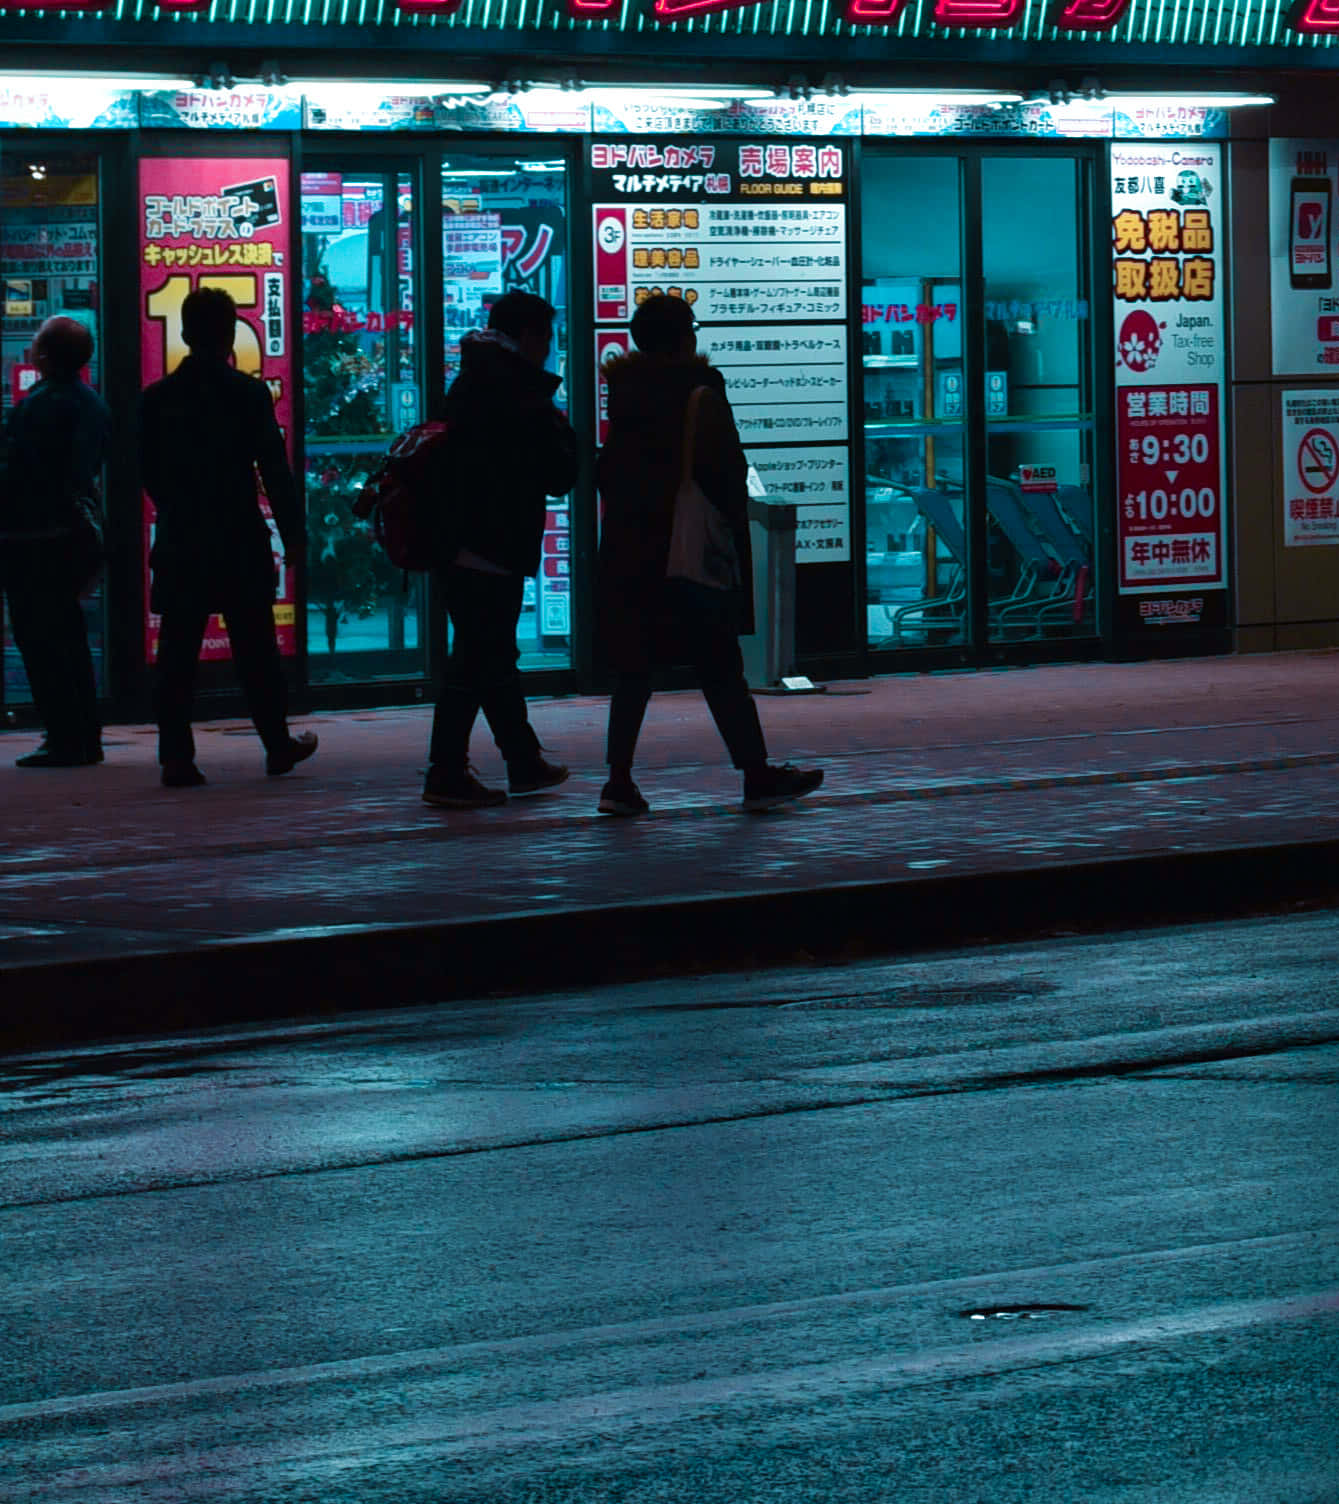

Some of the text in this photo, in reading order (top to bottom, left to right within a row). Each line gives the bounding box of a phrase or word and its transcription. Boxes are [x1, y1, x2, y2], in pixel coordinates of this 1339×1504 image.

[592, 143, 843, 178] ヨドバシカメラ 売場案内
[611, 173, 732, 195] マルチメディア札幌
[1114, 176, 1166, 195] 友都八喜
[145, 195, 260, 218] ゴールドポイント
[1113, 209, 1214, 254] 免税品
[1114, 255, 1215, 301] 取扱店
[710, 303, 841, 315] プラモデル・フィギュア・コミック
[1171, 333, 1215, 349] Tax-free
[1186, 350, 1215, 367] Shop
[1126, 389, 1211, 418] 営業時間
[1141, 432, 1210, 466] 9:30
[1031, 467, 1056, 479] AED
[1135, 487, 1217, 520] 10:00
[1131, 538, 1211, 566] 年中無休
